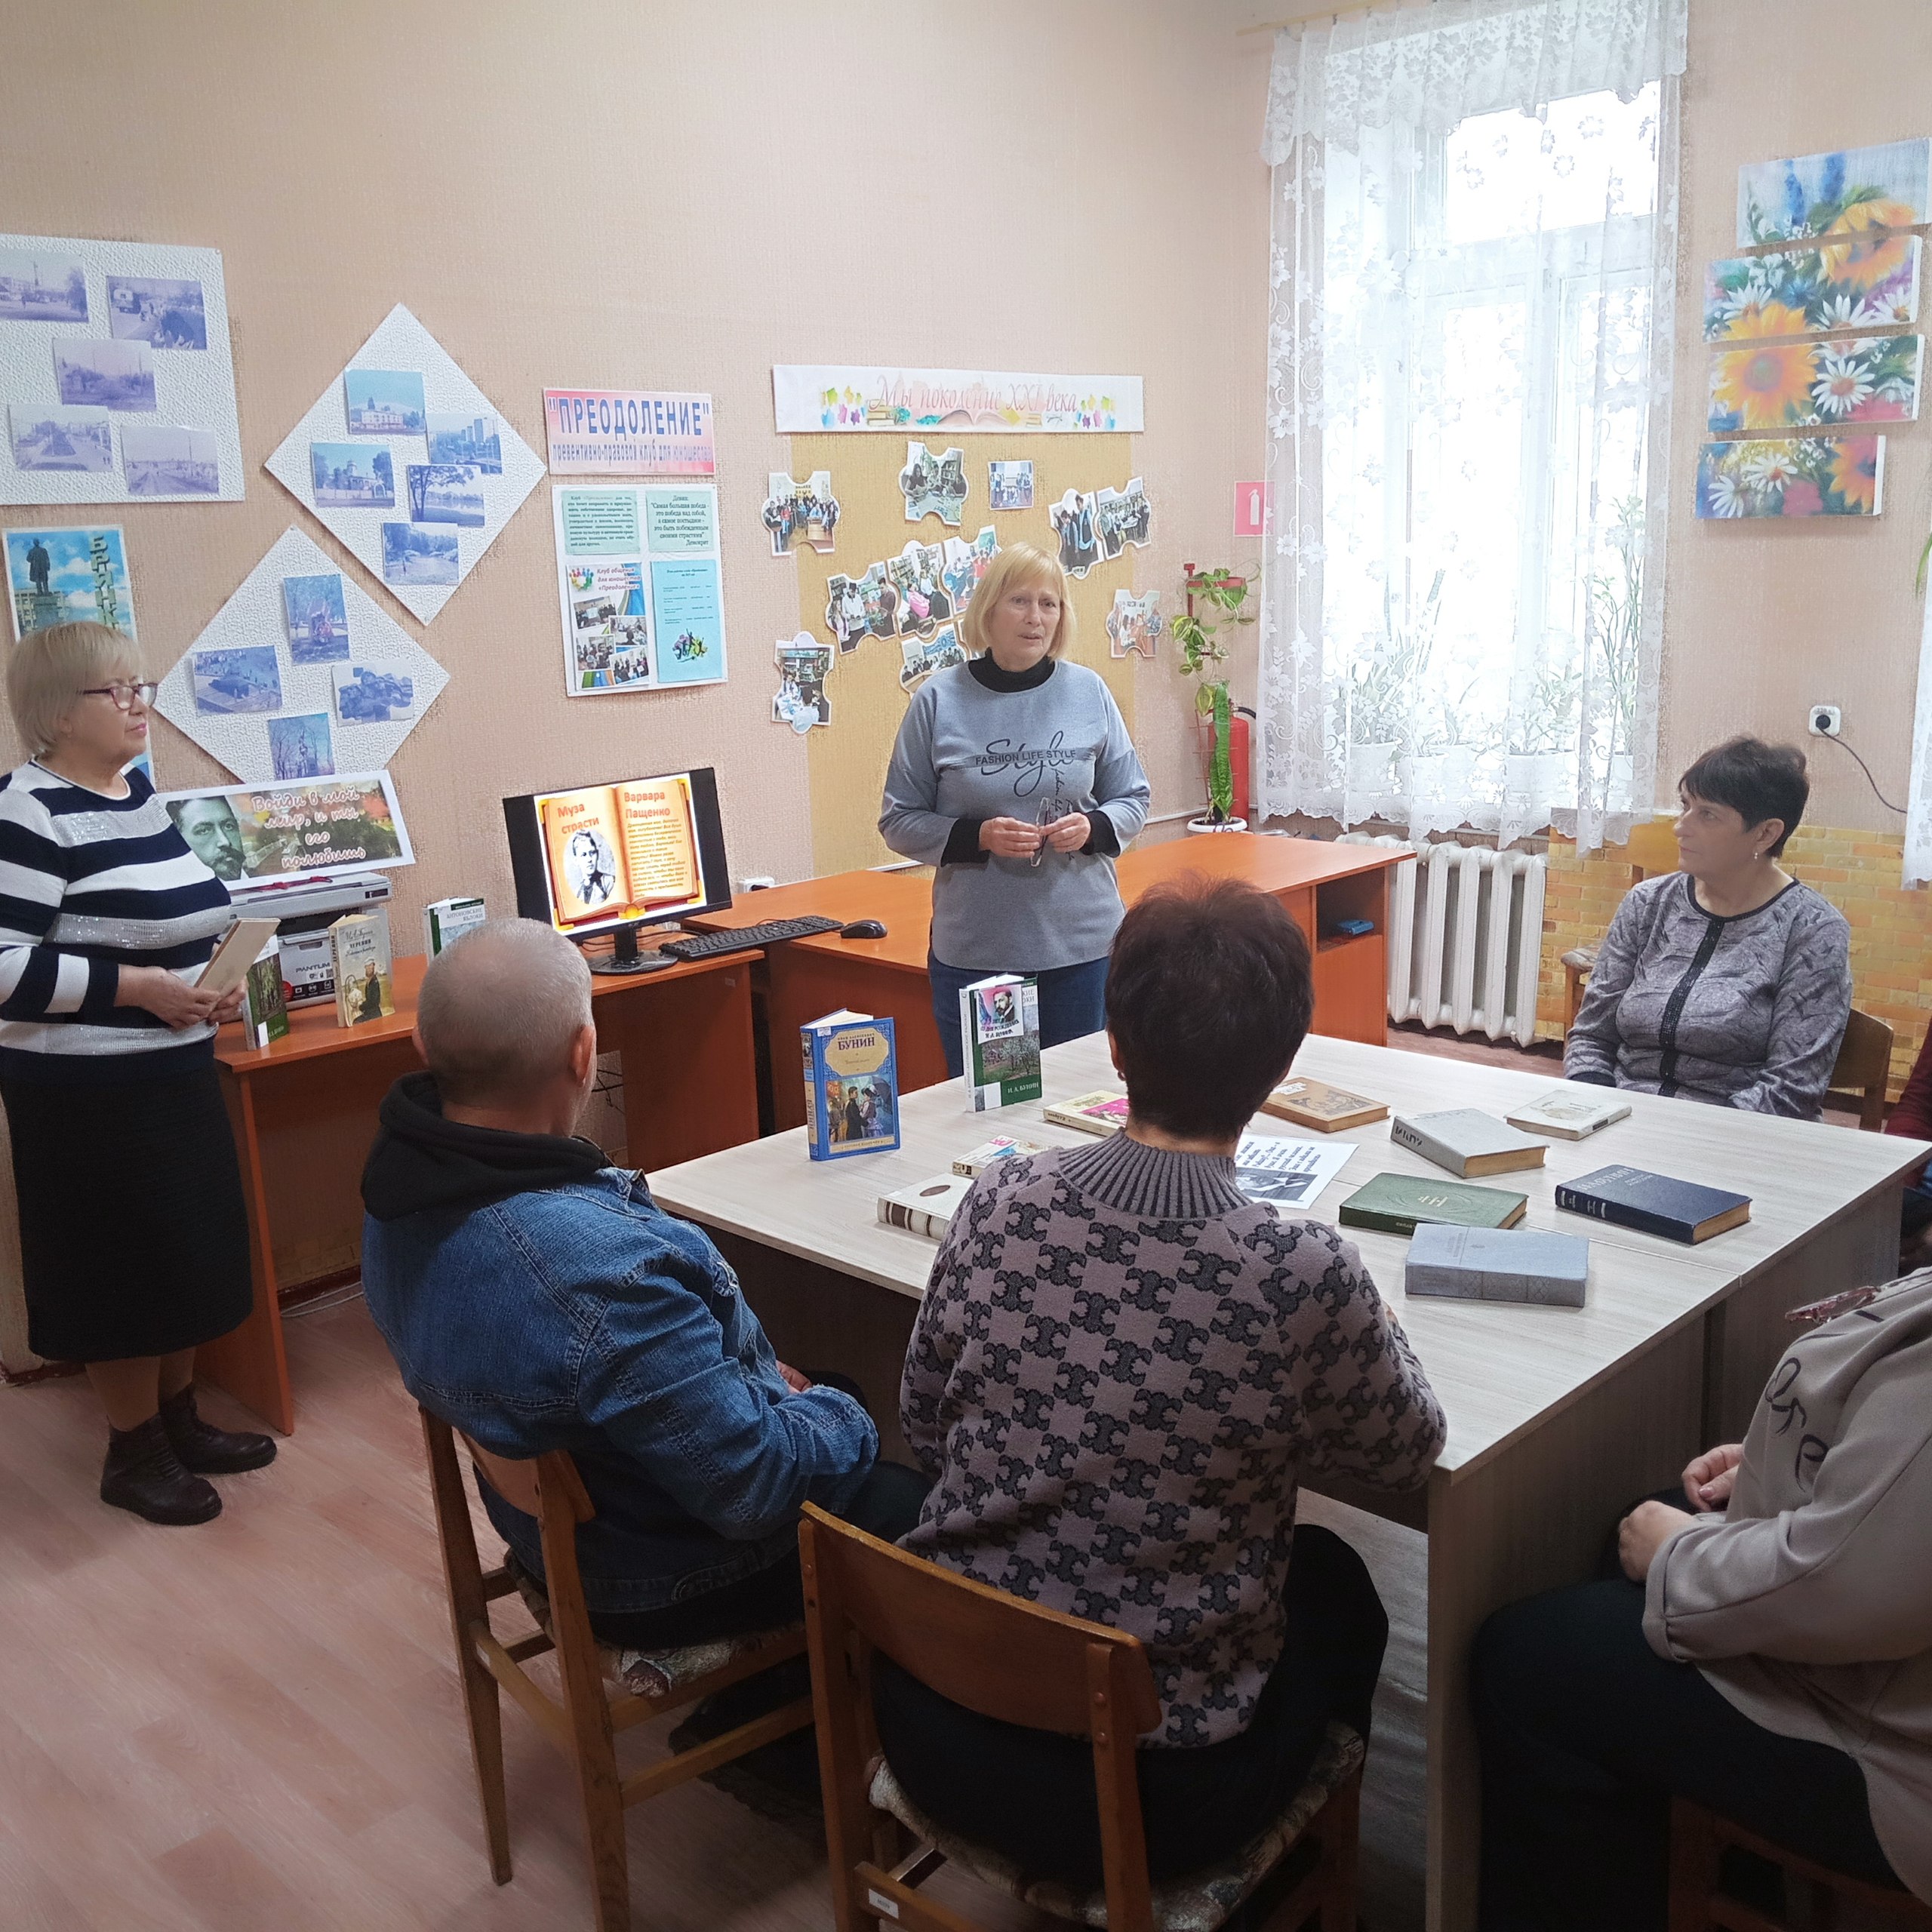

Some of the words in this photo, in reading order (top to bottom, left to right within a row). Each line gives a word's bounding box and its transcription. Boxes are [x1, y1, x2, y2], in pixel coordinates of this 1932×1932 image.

[868, 374, 913, 411] Мы
[921, 388, 1002, 411] поколение
[1006, 383, 1043, 411] XXI
[1046, 383, 1078, 413] века
[549, 398, 709, 441] "ПРЕОДОЛЕНИЕ"
[552, 439, 638, 466] превентивно-правовой
[639, 438, 657, 466] клуб
[658, 445, 671, 461] для
[88, 535, 120, 630] БРЯНК
[975, 754, 1020, 766] FASHION
[1022, 750, 1046, 761] LIFE
[1046, 749, 1076, 759] STYLE
[981, 730, 1074, 798] Style
[252, 792, 306, 813] Войди
[309, 789, 319, 805] в
[322, 786, 361, 804] мой
[623, 791, 666, 804] Варвара
[265, 813, 311, 829] мир,
[314, 811, 328, 823] и
[331, 808, 360, 822] ты
[557, 801, 586, 818] Муза
[625, 807, 671, 820] Пащенко
[561, 815, 600, 835] страсти
[304, 832, 331, 847] его
[281, 845, 367, 869] полюбишь
[295, 961, 331, 973] PANTUM
[838, 1036, 875, 1051] БУНИН
[1020, 1081, 1039, 1092] БУНИН
